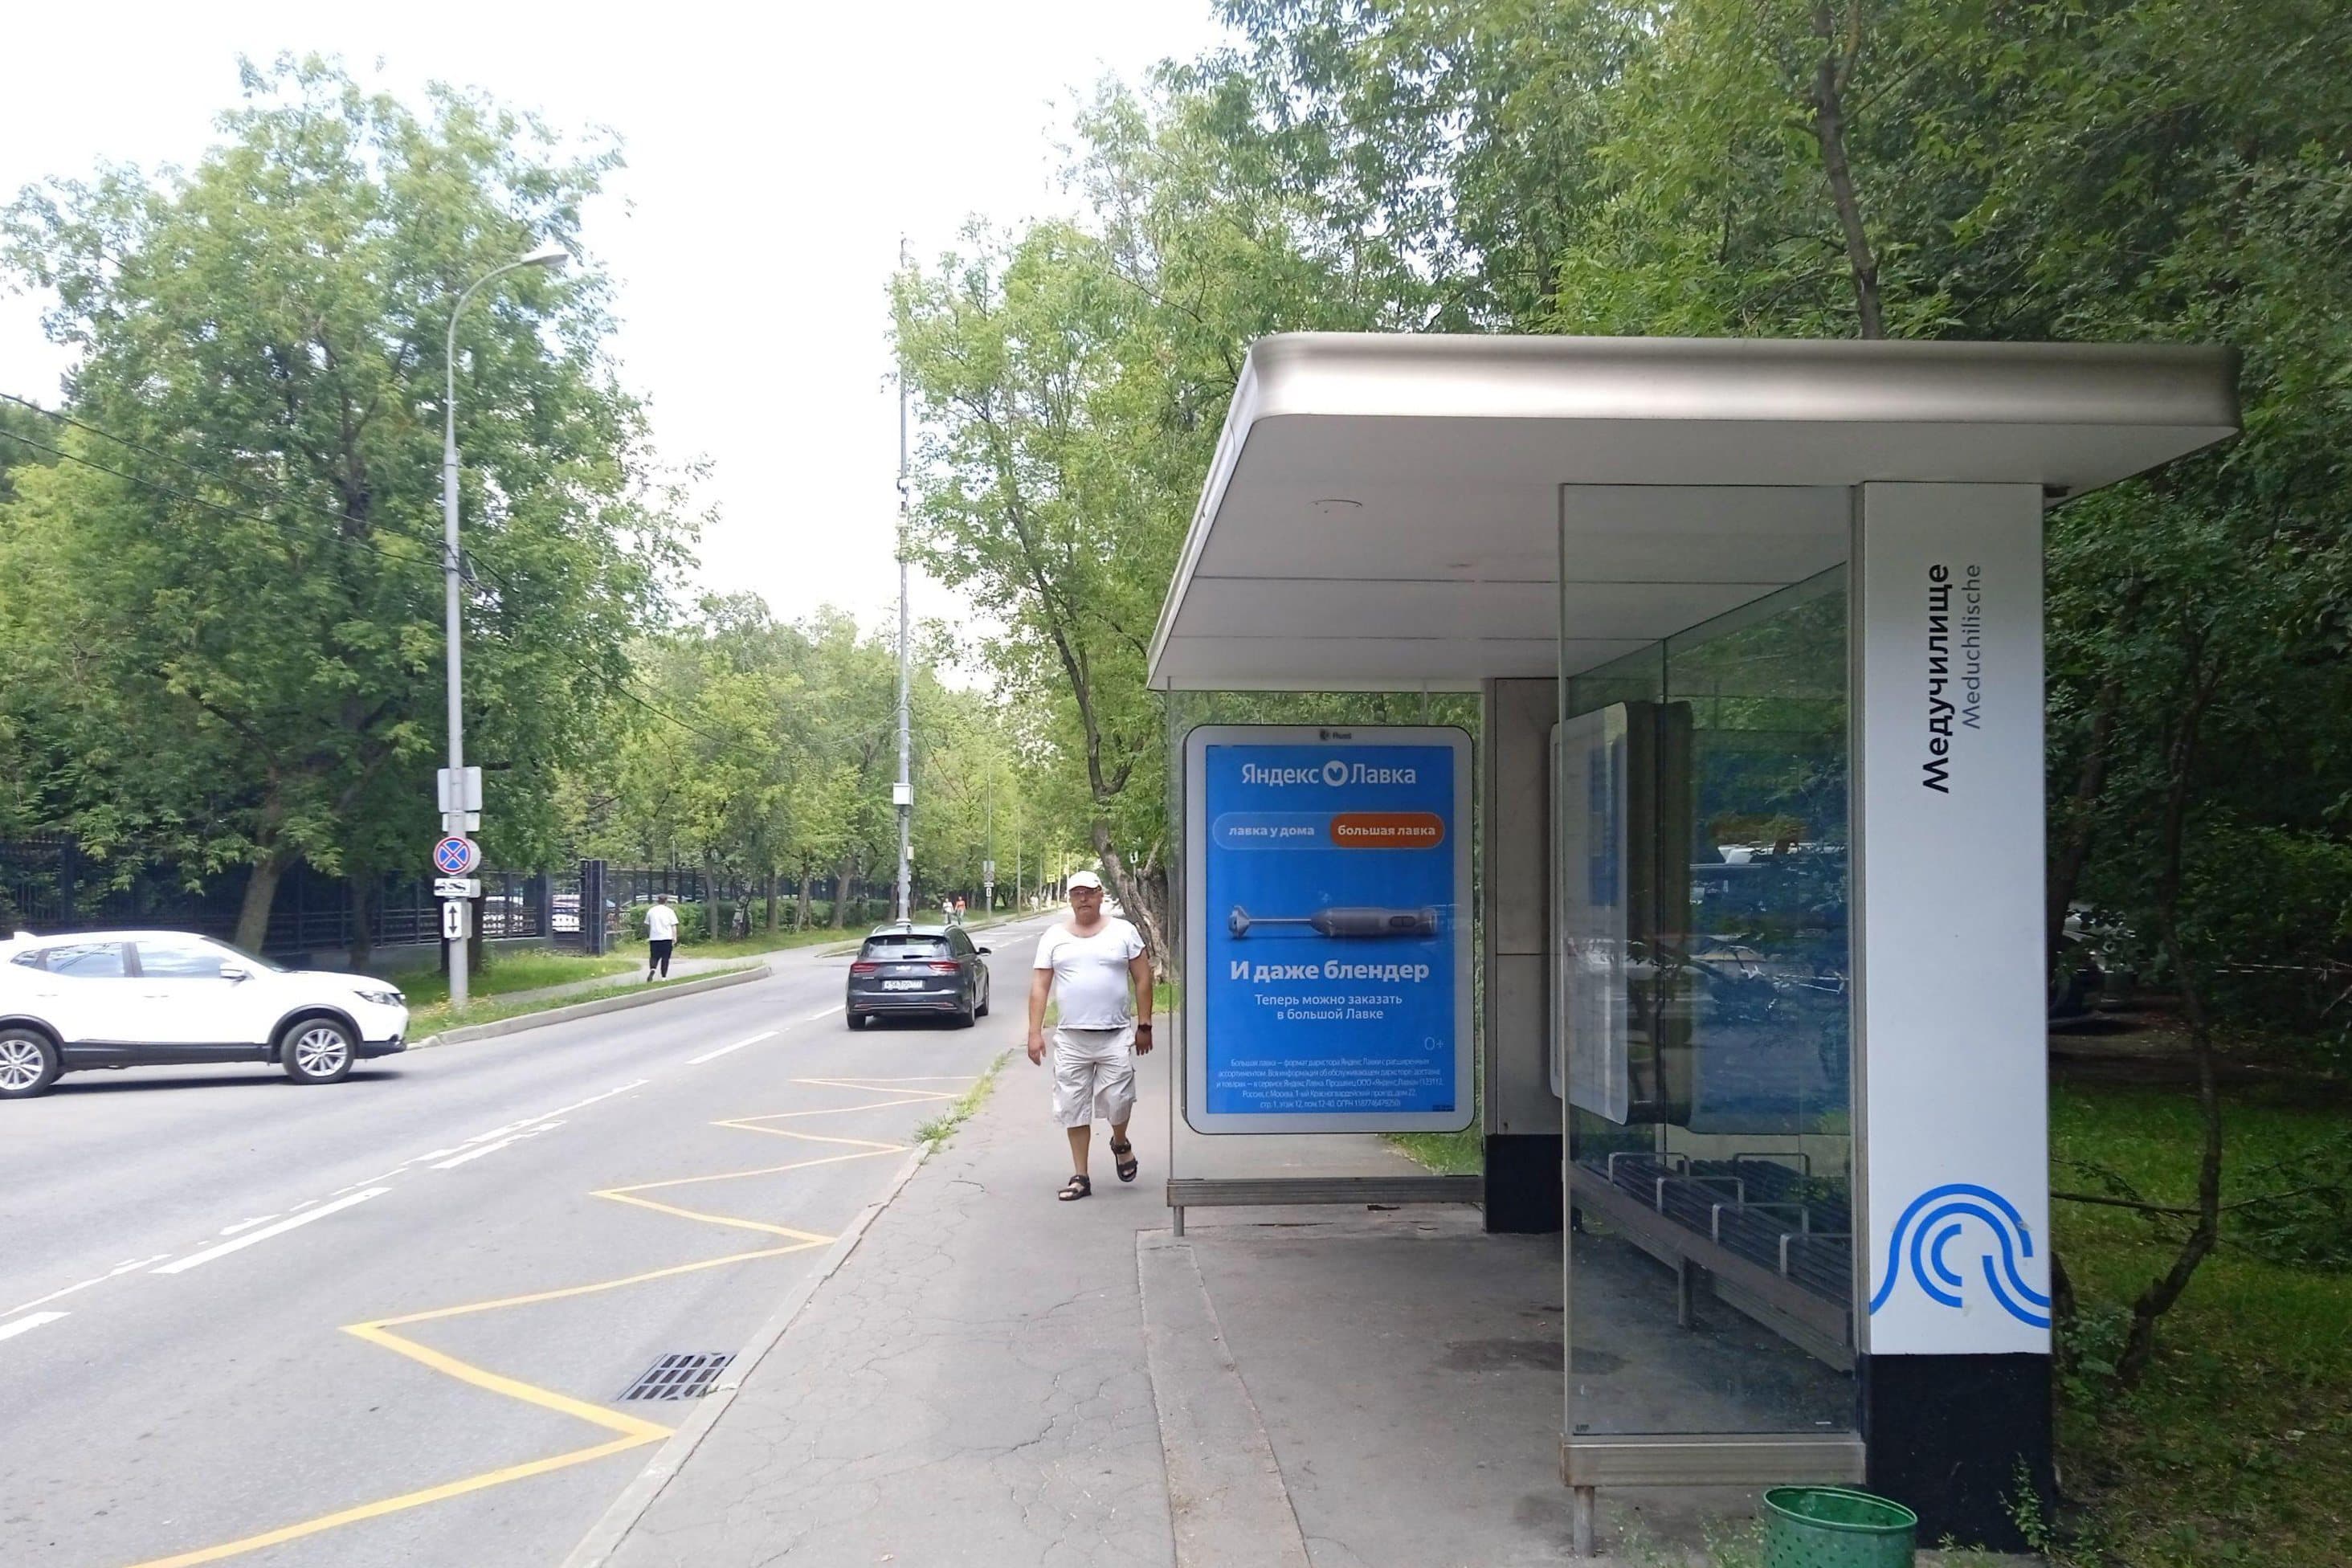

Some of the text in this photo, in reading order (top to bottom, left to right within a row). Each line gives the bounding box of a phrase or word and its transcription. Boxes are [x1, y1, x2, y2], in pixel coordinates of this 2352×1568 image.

[1962, 565, 1981, 729] Meduchilische
[1922, 564, 1955, 793] Медучилище
[1242, 763, 1416, 787] Яндекс Лавка
[1228, 827, 1314, 838] лавка у дома
[1338, 825, 1436, 836] большая лавка
[1231, 960, 1430, 983] И даже блендер
[1255, 994, 1403, 1008] Теперь можно заказать
[1277, 1008, 1384, 1020] в большой Лавке
